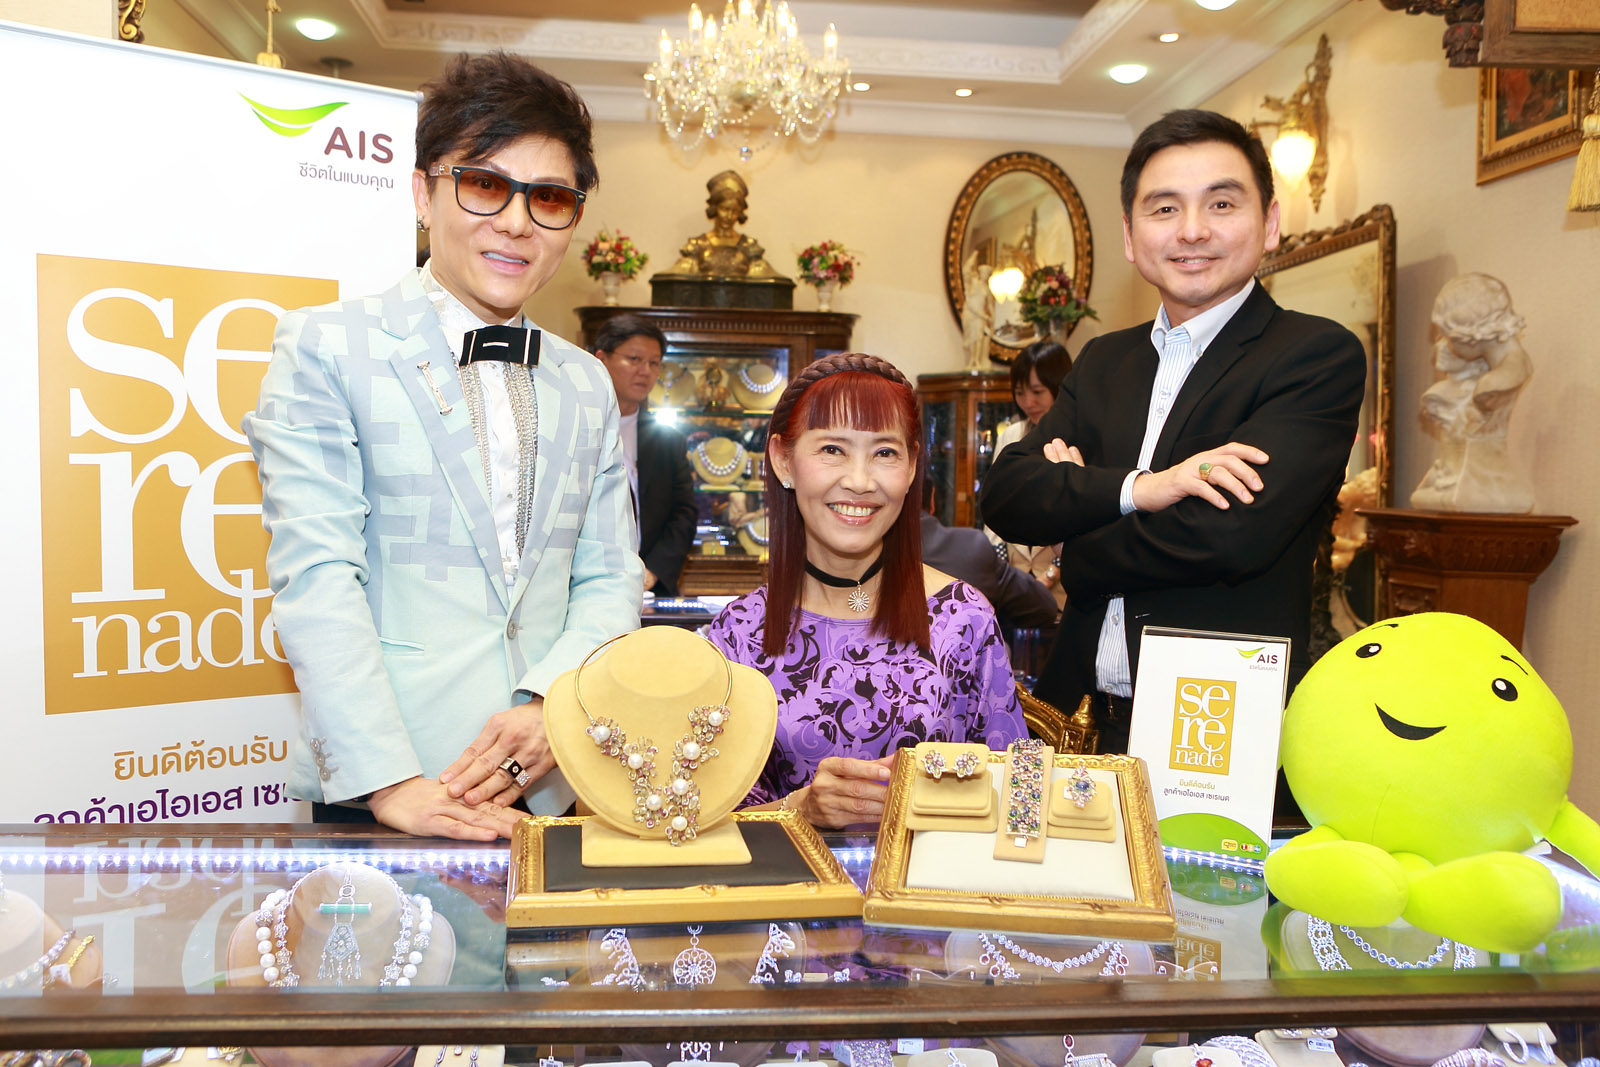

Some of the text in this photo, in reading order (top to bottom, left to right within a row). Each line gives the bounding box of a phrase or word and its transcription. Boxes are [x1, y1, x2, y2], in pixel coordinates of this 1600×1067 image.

[323, 126, 394, 164] AIS
[299, 162, 394, 191] ชีวิตในแบบคุณ
[1256, 653, 1278, 665] AIS
[1179, 682, 1231, 719] se
[1175, 716, 1227, 752] re
[114, 734, 289, 781] ยินดีต้อนรับ
[1173, 744, 1224, 768] nade
